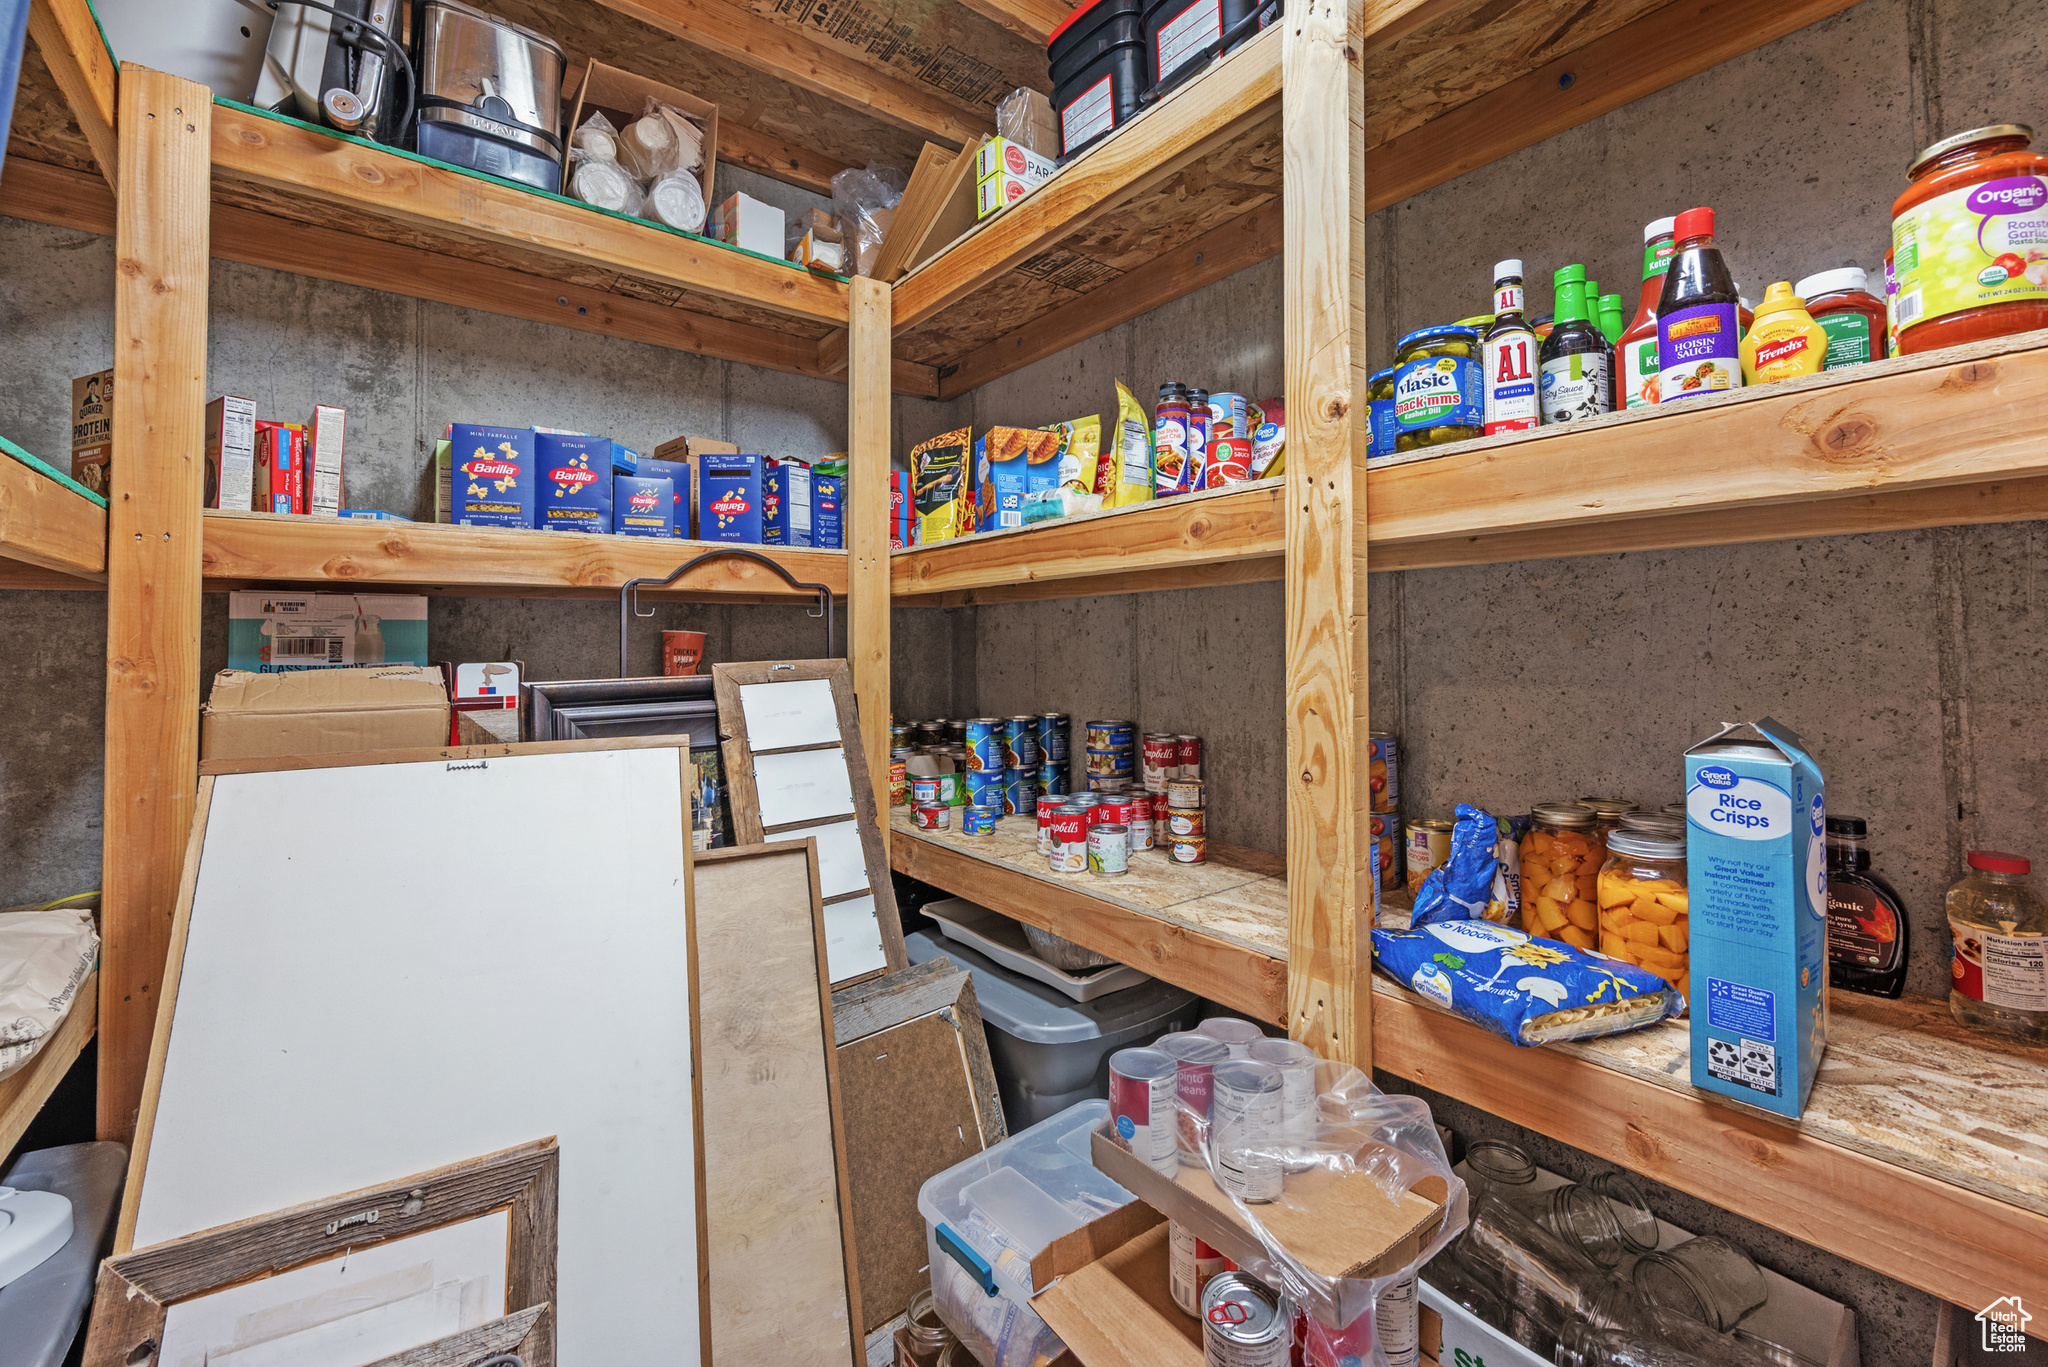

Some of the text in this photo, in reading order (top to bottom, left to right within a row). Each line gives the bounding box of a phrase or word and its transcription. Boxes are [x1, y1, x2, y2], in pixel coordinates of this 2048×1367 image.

[1950, 133, 1974, 143] CLOSE
[1976, 184, 2044, 203] Organic
[2012, 197, 2034, 205] Great
[2008, 228, 2048, 238] Garlic
[1984, 269, 2002, 277] USDA
[1674, 337, 1715, 352] HOISIN
[1677, 345, 1713, 360] SAUCE
[1757, 338, 1806, 364] French's
[1498, 387, 1531, 396] ORIGINAL
[1545, 385, 1584, 400] Soy Sauce
[79, 404, 103, 420] QUAKER
[1404, 406, 1441, 420] Kosher Dill
[73, 418, 111, 439] PROTEIN
[1257, 426, 1275, 436] Great
[72, 433, 111, 447] INSTANT OATMEAL
[79, 447, 101, 457] BANANA NUT
[1254, 445, 1269, 454] Garlic
[473, 463, 514, 474] Barilla
[554, 471, 592, 482] Barilla
[632, 497, 657, 505] Barilla
[715, 502, 746, 511] Barilla
[260, 664, 302, 674] GLASS
[893, 774, 905, 782] HOT
[1700, 769, 1731, 781] Great
[1707, 777, 1732, 786] Value
[1719, 793, 1762, 811] Rice
[1811, 803, 1825, 821] Great
[1710, 808, 1770, 829] Crisps
[1708, 855, 1726, 865] Why
[1743, 861, 1754, 870] try
[1714, 864, 1764, 878] Great Value
[1704, 870, 1775, 888] Instant Oatmeal?
[1720, 882, 1749, 892] comes
[1705, 887, 1733, 898] variety
[1745, 894, 1775, 905] flavors.
[1724, 899, 1750, 908] made
[1751, 904, 1770, 912] with
[1705, 903, 1776, 921] whole grain oats
[1702, 910, 1719, 918] and
[1735, 917, 1759, 926] great
[1760, 921, 1780, 931] way
[1835, 915, 1852, 923] pure
[1716, 921, 1734, 929] start
[1736, 925, 1755, 933] your
[1756, 929, 1776, 938] day.
[1836, 922, 1858, 930] syrup
[1452, 925, 1504, 944] Noodles
[1986, 936, 2022, 947] Nutrition
[1986, 955, 2021, 966] Calories
[1455, 970, 1465, 978] NET
[1423, 978, 1440, 991] Medium
[1414, 980, 1449, 1002] Egg Noodles
[1731, 984, 1772, 998] Great Quality.
[1731, 989, 1765, 1002] Great Price.
[1731, 994, 1768, 1007] Guaranteed.
[1713, 1065, 1736, 1076] PAPER
[1178, 1072, 1204, 1084] pinto
[1717, 1073, 1733, 1082] BOX
[1743, 1075, 1774, 1088] PLASTIC
[1178, 1084, 1207, 1096] beans
[1750, 1083, 1766, 1092] BAG
[1231, 1094, 1245, 1102] Facts
[1210, 1335, 1226, 1350] Facts
